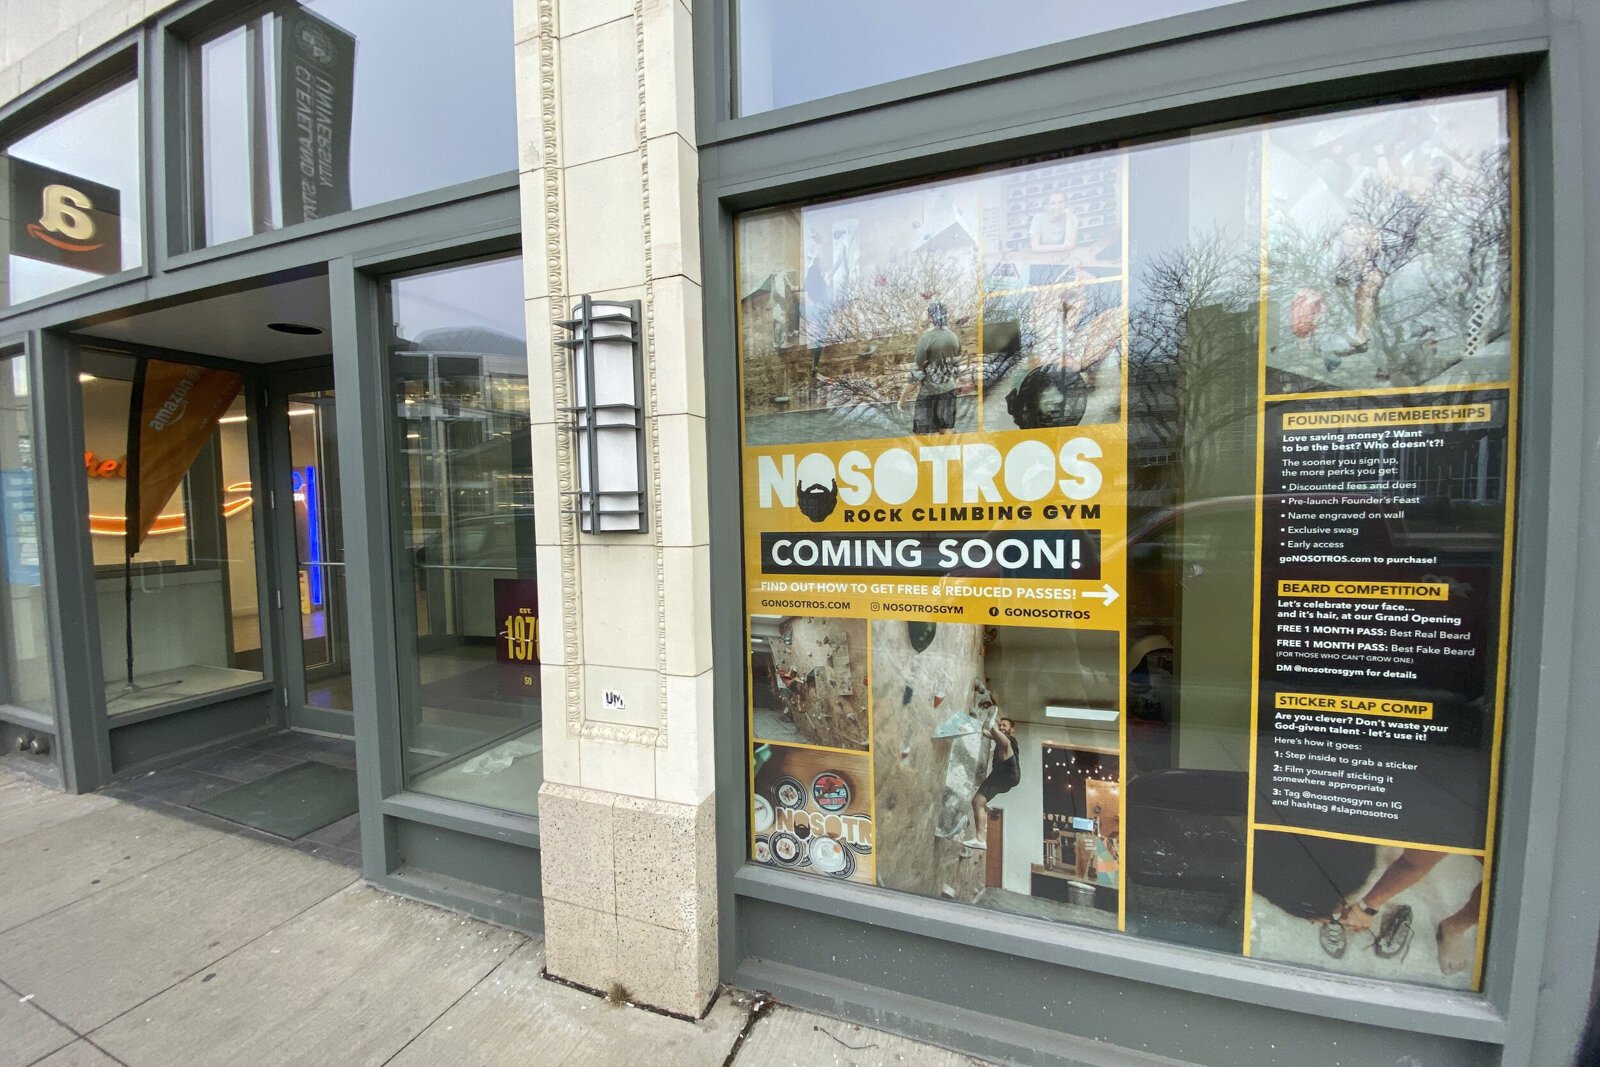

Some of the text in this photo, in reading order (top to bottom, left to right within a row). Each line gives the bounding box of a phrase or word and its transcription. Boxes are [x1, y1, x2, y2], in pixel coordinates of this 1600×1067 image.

[150, 379, 194, 431] amazon
[1288, 407, 1485, 426] FOUNDING MEMBERSHIPS
[1310, 433, 1344, 442] saving
[1347, 431, 1390, 440] money?
[1393, 430, 1422, 438] Want
[1364, 441, 1389, 449] Who
[1392, 439, 1443, 448] doesn't?!
[1339, 459, 1356, 467] you
[1359, 458, 1380, 466] sign
[758, 437, 1103, 512] NOSOTROS
[1282, 469, 1297, 477] the
[1328, 468, 1354, 478] perks
[1357, 469, 1375, 477] you
[1379, 468, 1398, 476] get:
[1289, 482, 1344, 490] Discounted
[1347, 482, 1367, 490] fees
[1392, 481, 1416, 489] dues
[1393, 496, 1420, 504] Feast
[844, 504, 1100, 522] ROCK CLIMBING GYM
[1319, 512, 1366, 521] engraved
[1288, 526, 1331, 534] Exclusive
[1288, 541, 1310, 549] Early
[772, 539, 1081, 569] COMING SOON!
[1280, 555, 1371, 564] goNOSOTROS.com
[1387, 557, 1436, 565] purchase!
[761, 582, 1076, 599] FIND OUT HOW TO GET FREE & REDUCED PASSES!
[1283, 584, 1441, 596] BEARD COMPETITION
[762, 600, 850, 609] GONOSOTROS.COM
[883, 603, 964, 614] NOSOTROSGYM
[1278, 600, 1301, 608] Let's
[1303, 601, 1351, 609] celebrate
[1382, 603, 1415, 611] face...
[1005, 608, 1090, 619] GONOSOTROS
[1299, 611, 1314, 619] it's
[1317, 612, 1339, 620] hair,
[1375, 613, 1408, 622] Grand
[1411, 615, 1462, 625] Opening
[1313, 626, 1354, 634] MONTH
[1357, 628, 1386, 636] PASS:
[1390, 629, 1412, 637] Best
[1415, 630, 1436, 638] Real
[1440, 631, 1470, 640] Beard
[1313, 641, 1355, 649] MONTH
[1358, 643, 1388, 651] PASS:
[1391, 644, 1413, 652] Best
[1416, 646, 1440, 654] Fake
[1444, 647, 1475, 656] Beard
[1294, 665, 1364, 676] @nosotrosgym
[1383, 670, 1417, 679] details
[1279, 697, 1428, 715] STICKER SLAP COMP
[1275, 712, 1292, 720] Are
[1315, 715, 1352, 724] clever?
[1356, 718, 1385, 727] Don't
[1388, 721, 1420, 730] waste
[1275, 723, 1326, 732] God-given
[1329, 726, 1360, 735] talent
[1369, 729, 1391, 738] let's
[1394, 732, 1412, 740] use
[1415, 733, 1427, 741] it!
[1274, 737, 1362, 751] Here's how it goes:
[1285, 752, 1306, 760] Step
[1308, 753, 1336, 762] inside
[1352, 757, 1374, 767] grab
[1385, 761, 1418, 770] sticker
[1306, 766, 1344, 778] yourself
[1347, 772, 1384, 783] sticking
[1273, 775, 1386, 793] somewhere appropriate
[1284, 789, 1300, 799] Tag
[1302, 791, 1373, 806] @nosotrosgym
[1291, 800, 1328, 812] hashtag
[1331, 804, 1398, 820] #slapnosotros
